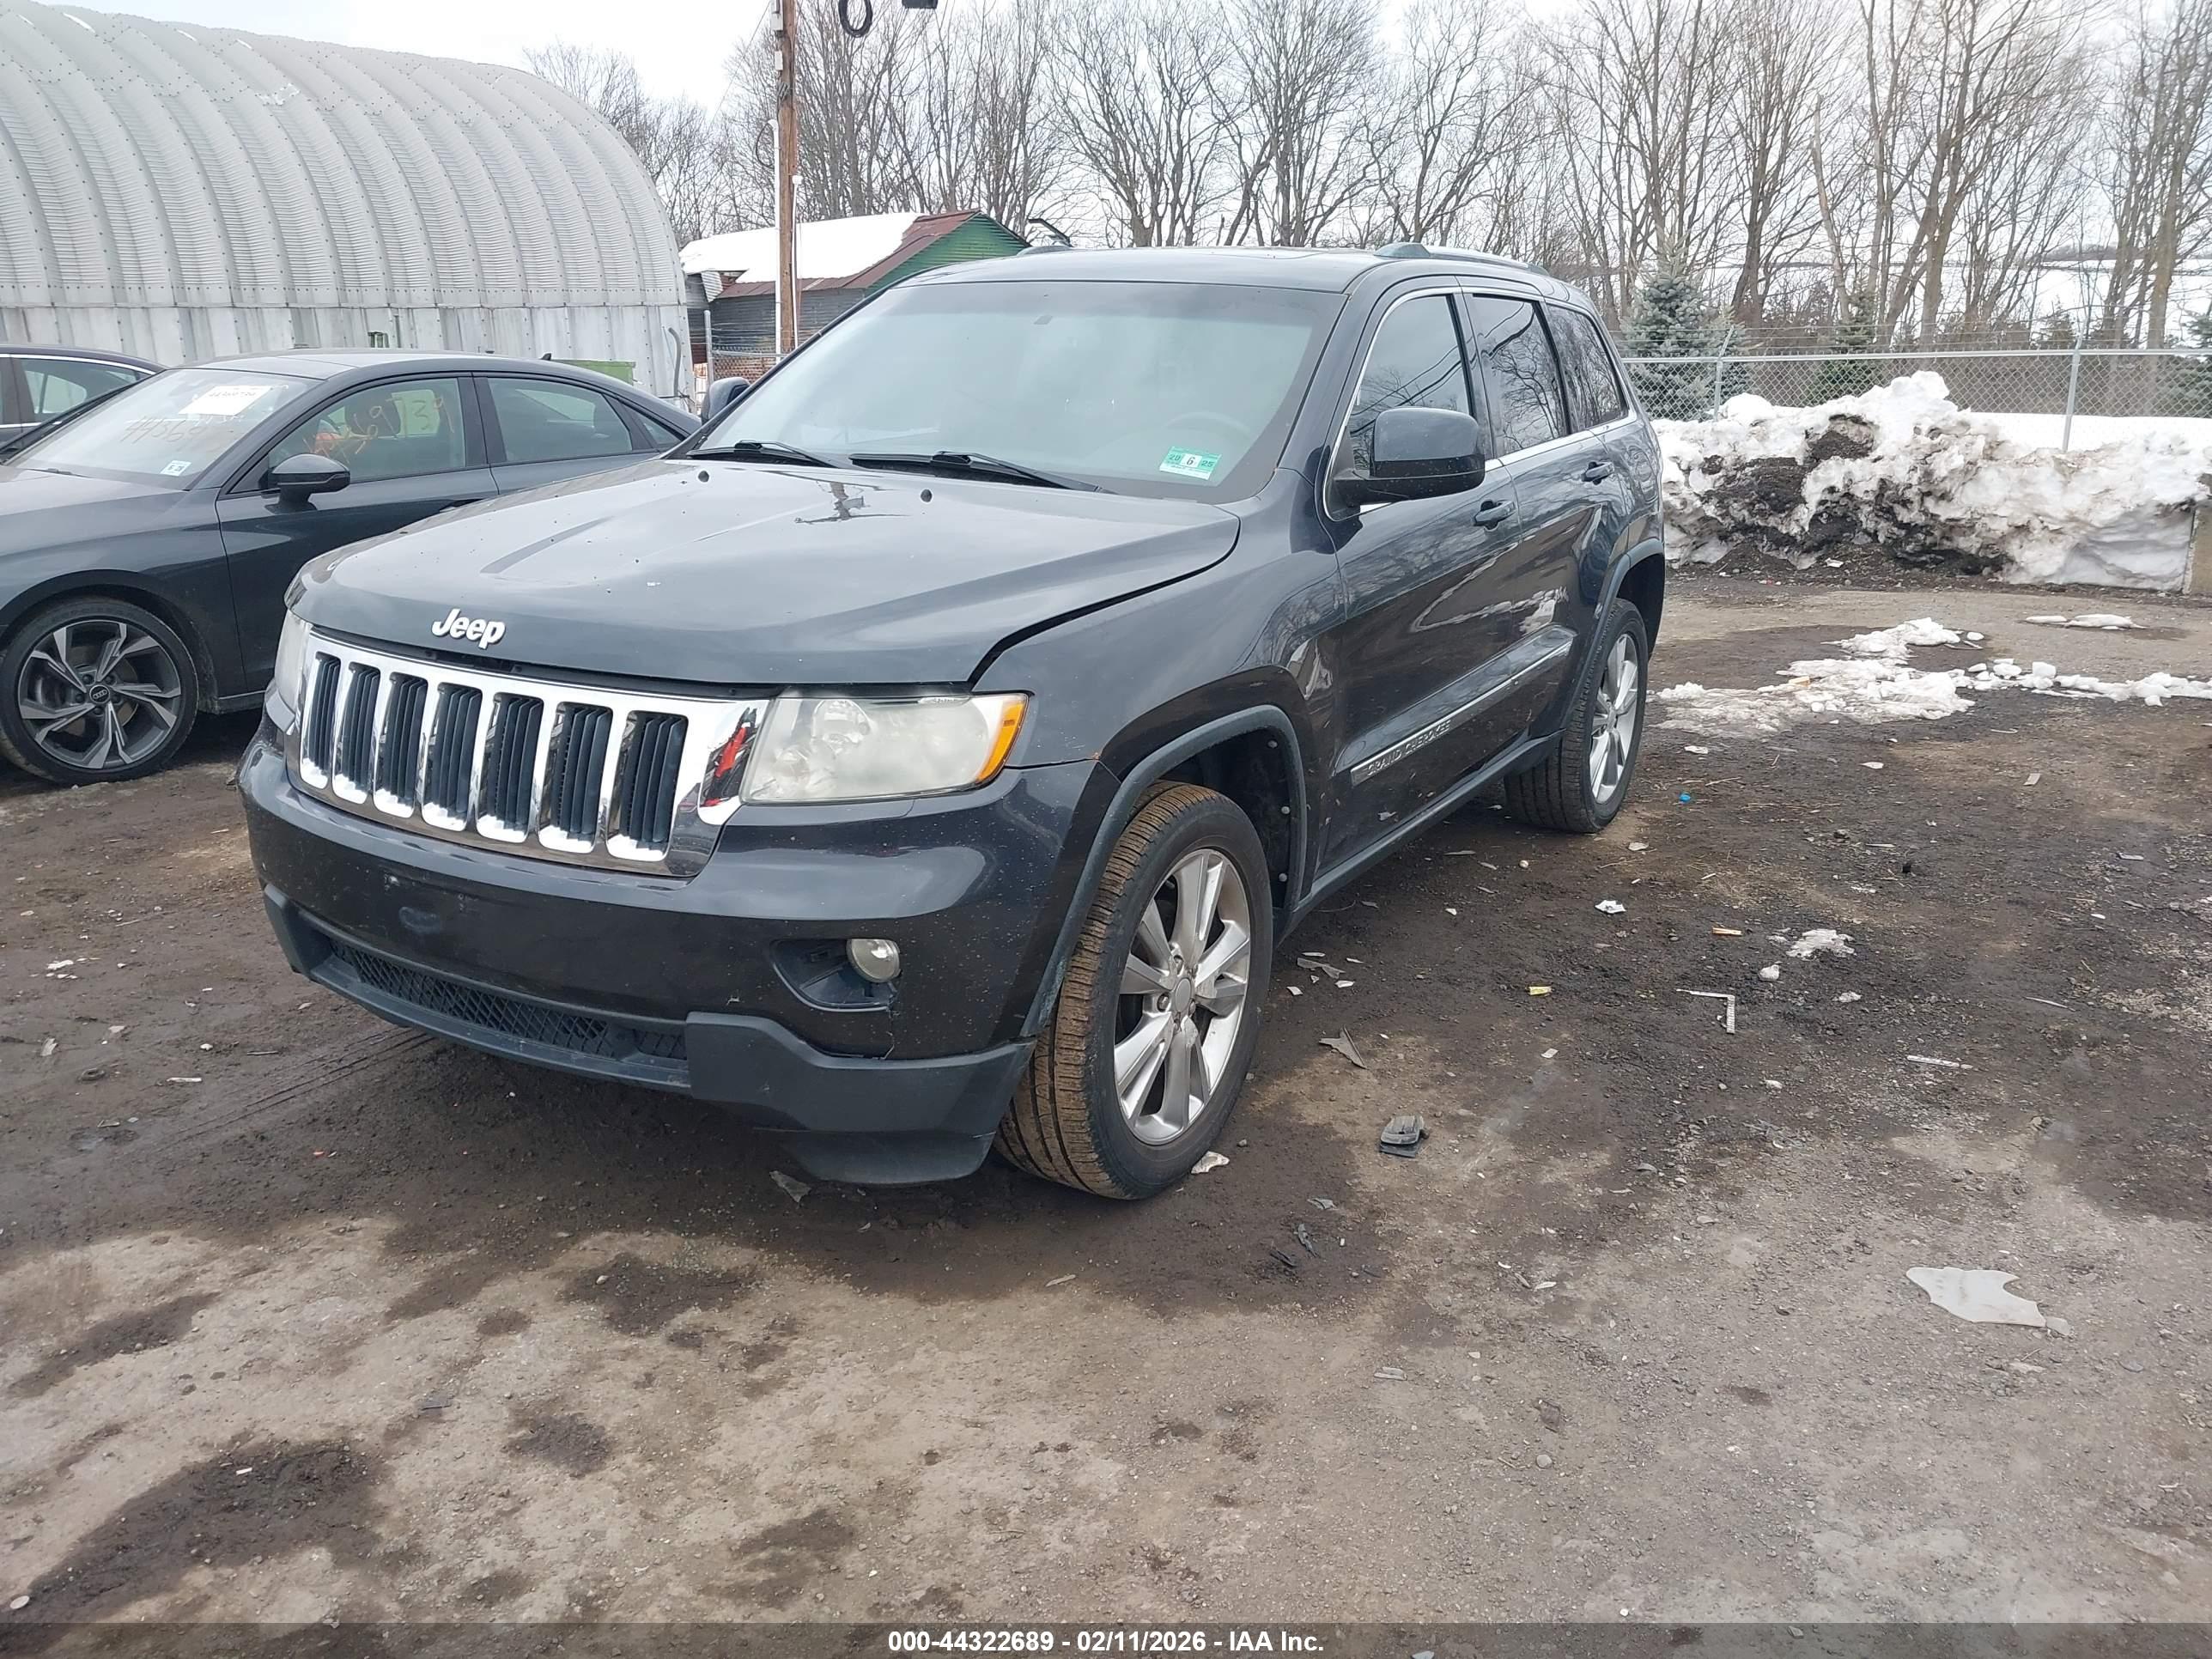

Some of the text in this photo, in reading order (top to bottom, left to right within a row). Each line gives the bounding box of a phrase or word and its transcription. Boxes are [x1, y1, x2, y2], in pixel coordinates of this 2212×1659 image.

[1186, 456, 1196, 465] 6
[1201, 459, 1215, 468] 25
[431, 608, 506, 650] Jeep
